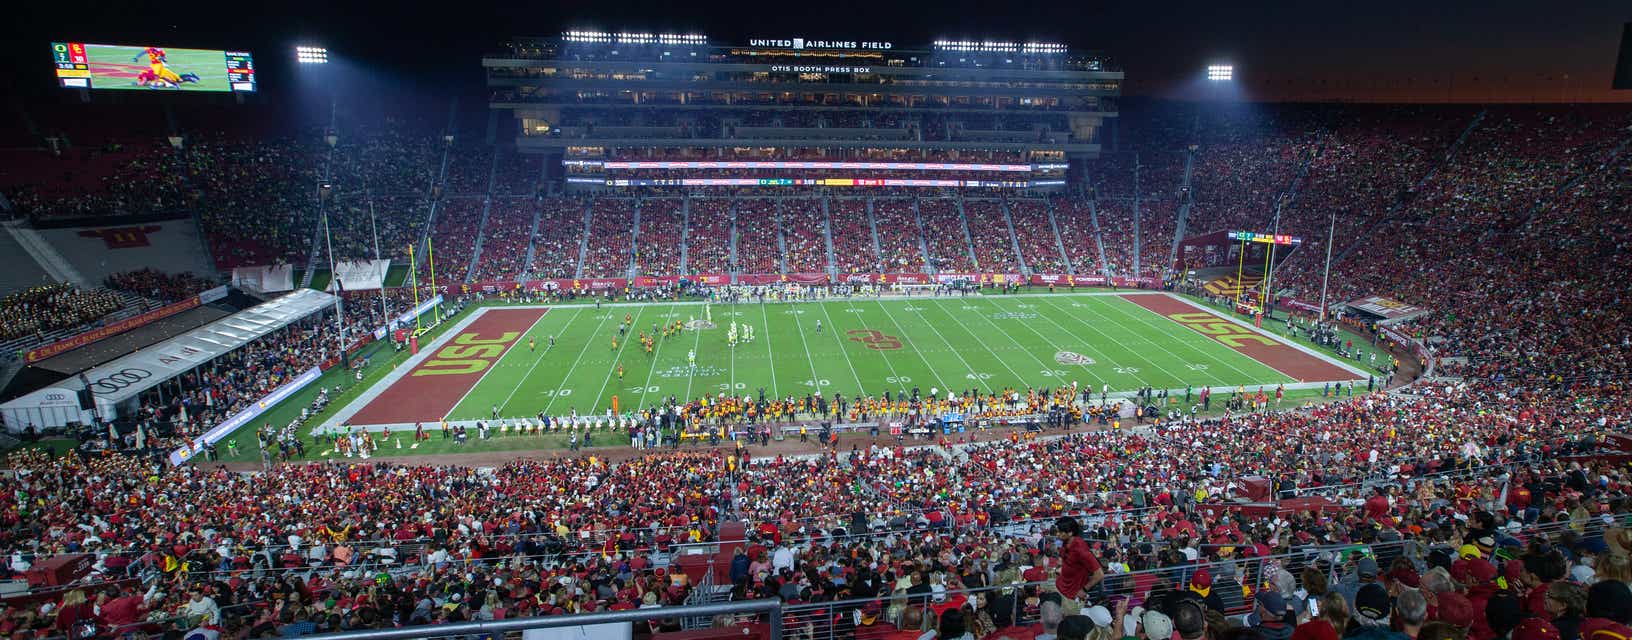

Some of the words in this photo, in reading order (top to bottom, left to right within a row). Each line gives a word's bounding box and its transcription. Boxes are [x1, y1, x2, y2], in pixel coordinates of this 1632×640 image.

[750, 39, 791, 47] UNITED
[806, 40, 857, 48] AIRLINES
[862, 41, 892, 49] FIELD
[1168, 312, 1281, 348] USC
[411, 331, 520, 377] USC
[804, 379, 831, 387] 40
[886, 376, 912, 384] 50
[631, 385, 660, 393] 20
[718, 382, 747, 390] 30
[546, 388, 573, 397] 10
